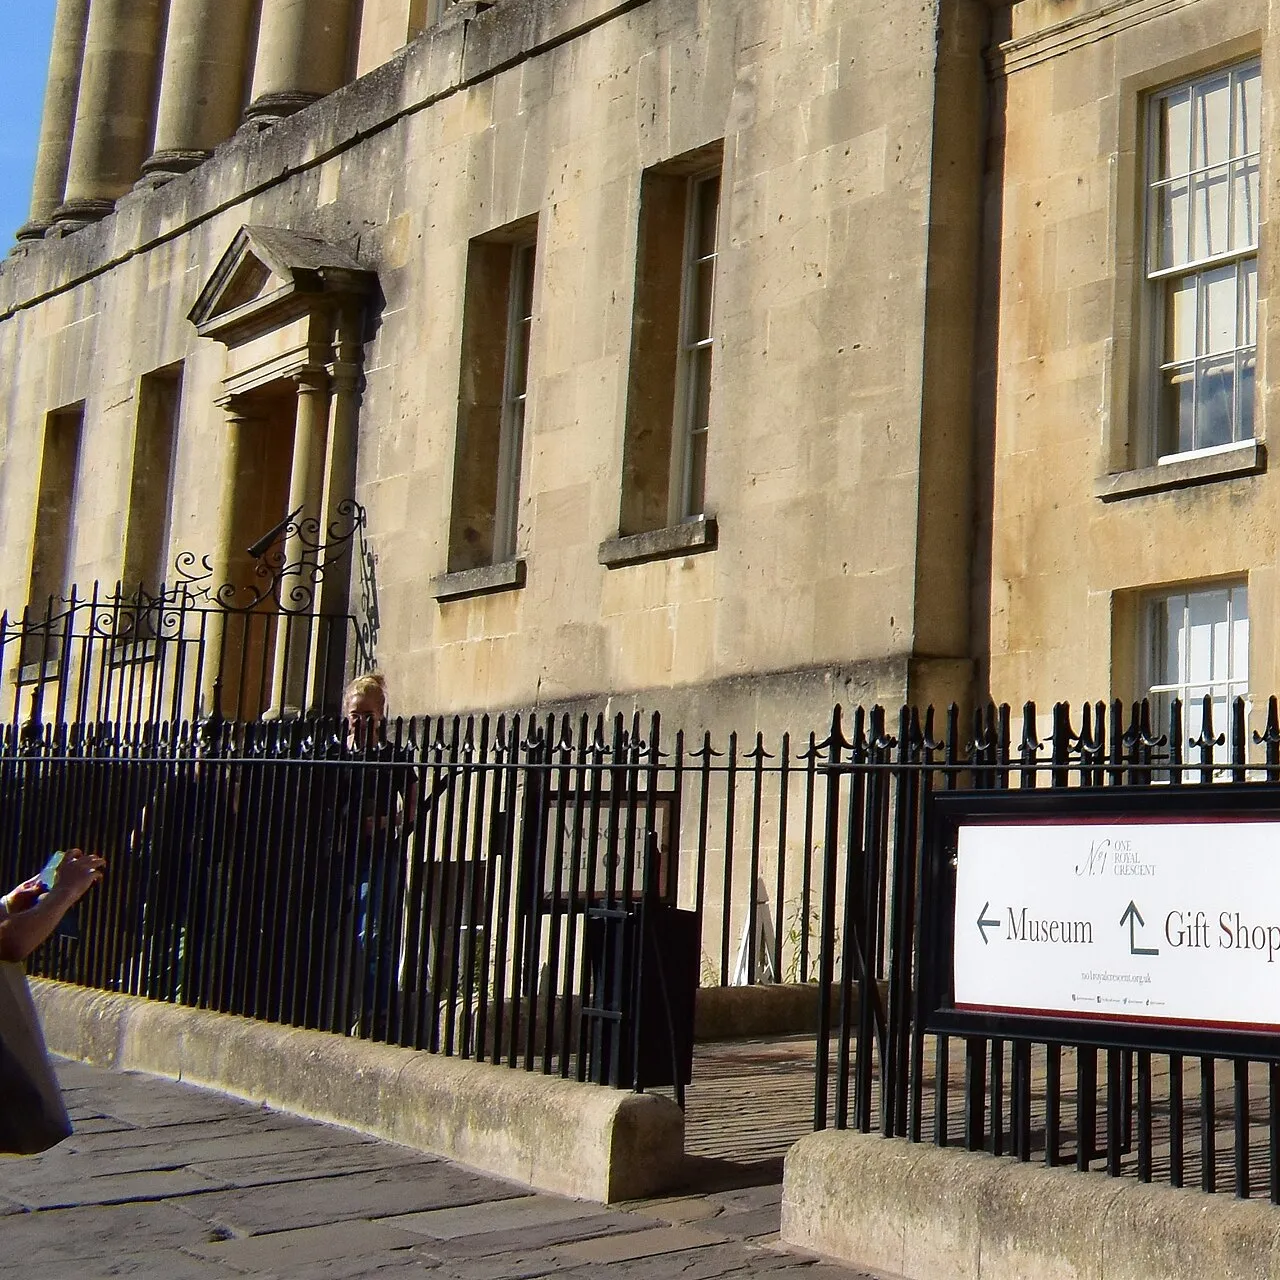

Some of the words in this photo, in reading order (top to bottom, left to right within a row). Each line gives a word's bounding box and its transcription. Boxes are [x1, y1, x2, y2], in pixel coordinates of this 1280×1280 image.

[1114, 839, 1132, 852] ONE
[1113, 852, 1141, 864] ROYAL
[1113, 864, 1156, 877] CRESCENT
[1006, 907, 1094, 945] Museum
[1165, 910, 1211, 950] Gift
